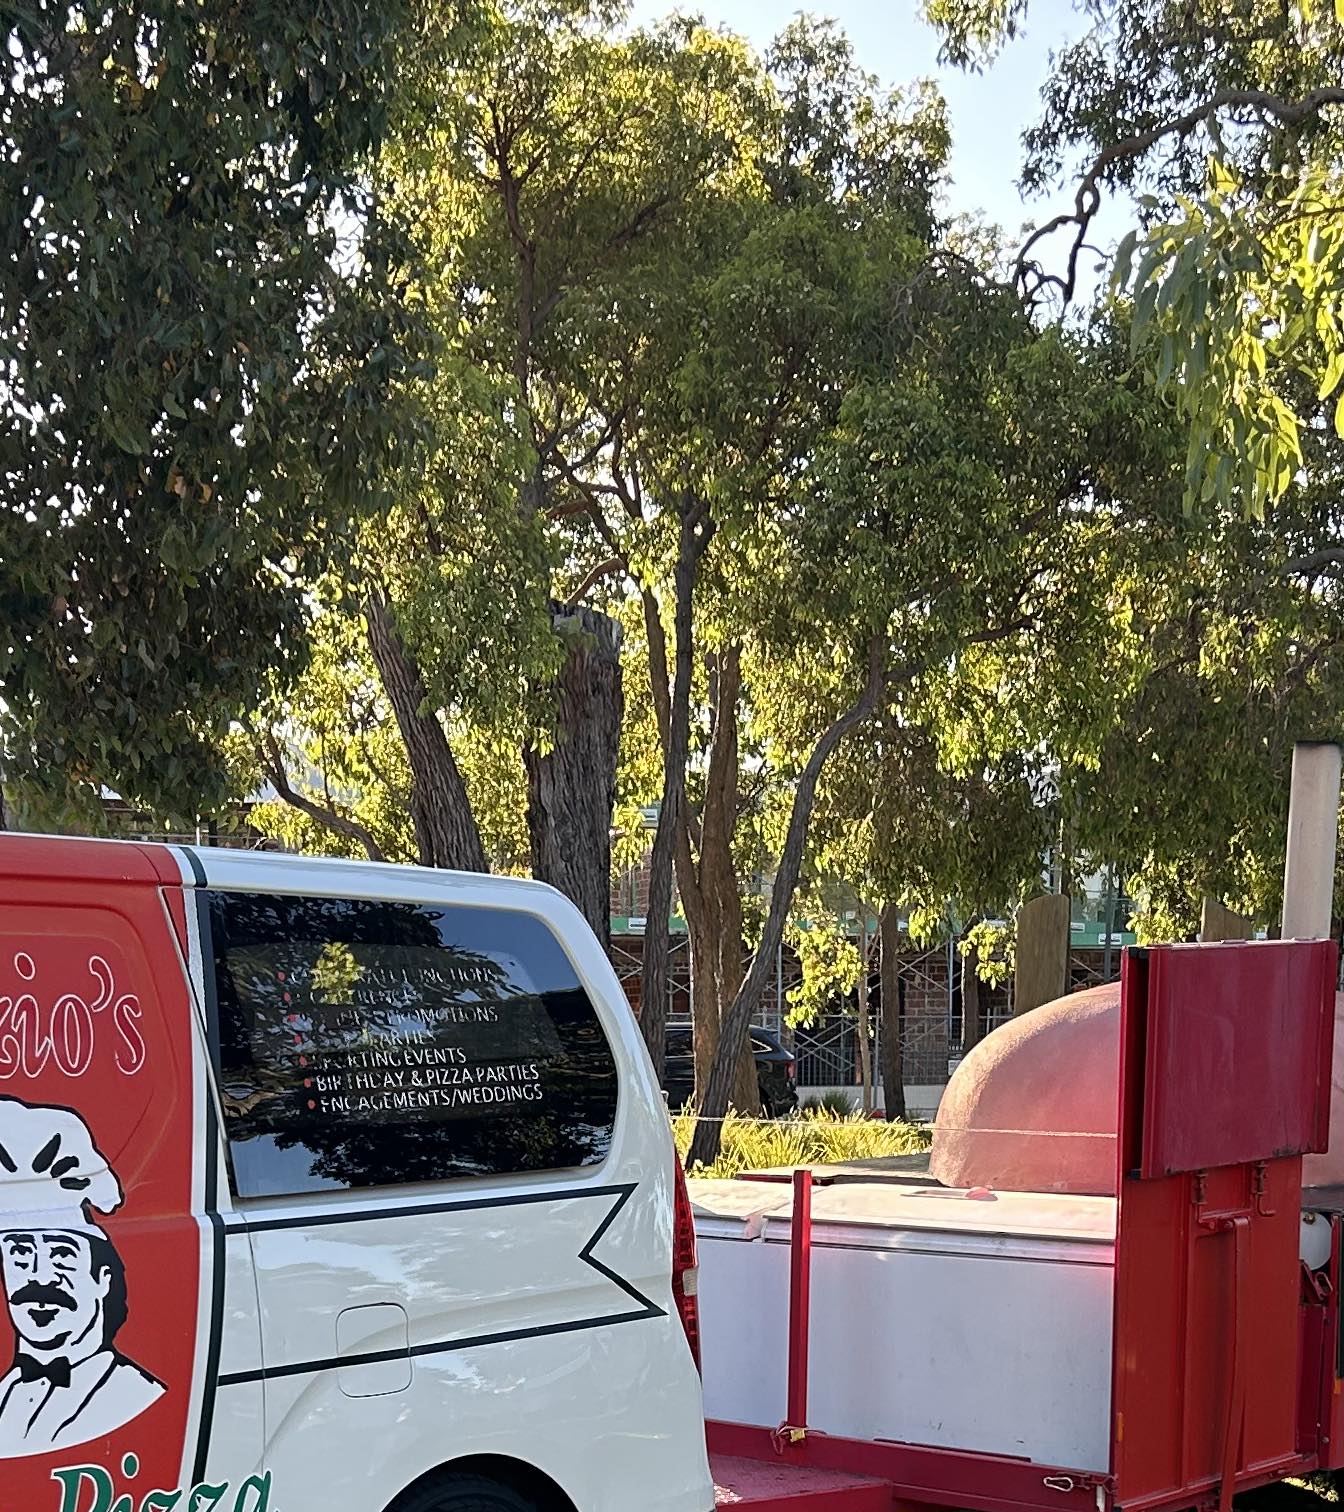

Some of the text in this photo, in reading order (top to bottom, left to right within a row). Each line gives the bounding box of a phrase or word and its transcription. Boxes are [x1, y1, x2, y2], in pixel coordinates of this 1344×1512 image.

[313, 1047, 467, 1071] PRTING EVENTS
[411, 1070, 424, 1087] &
[425, 1067, 474, 1087] PIZZA
[475, 1064, 540, 1083] PARTIES
